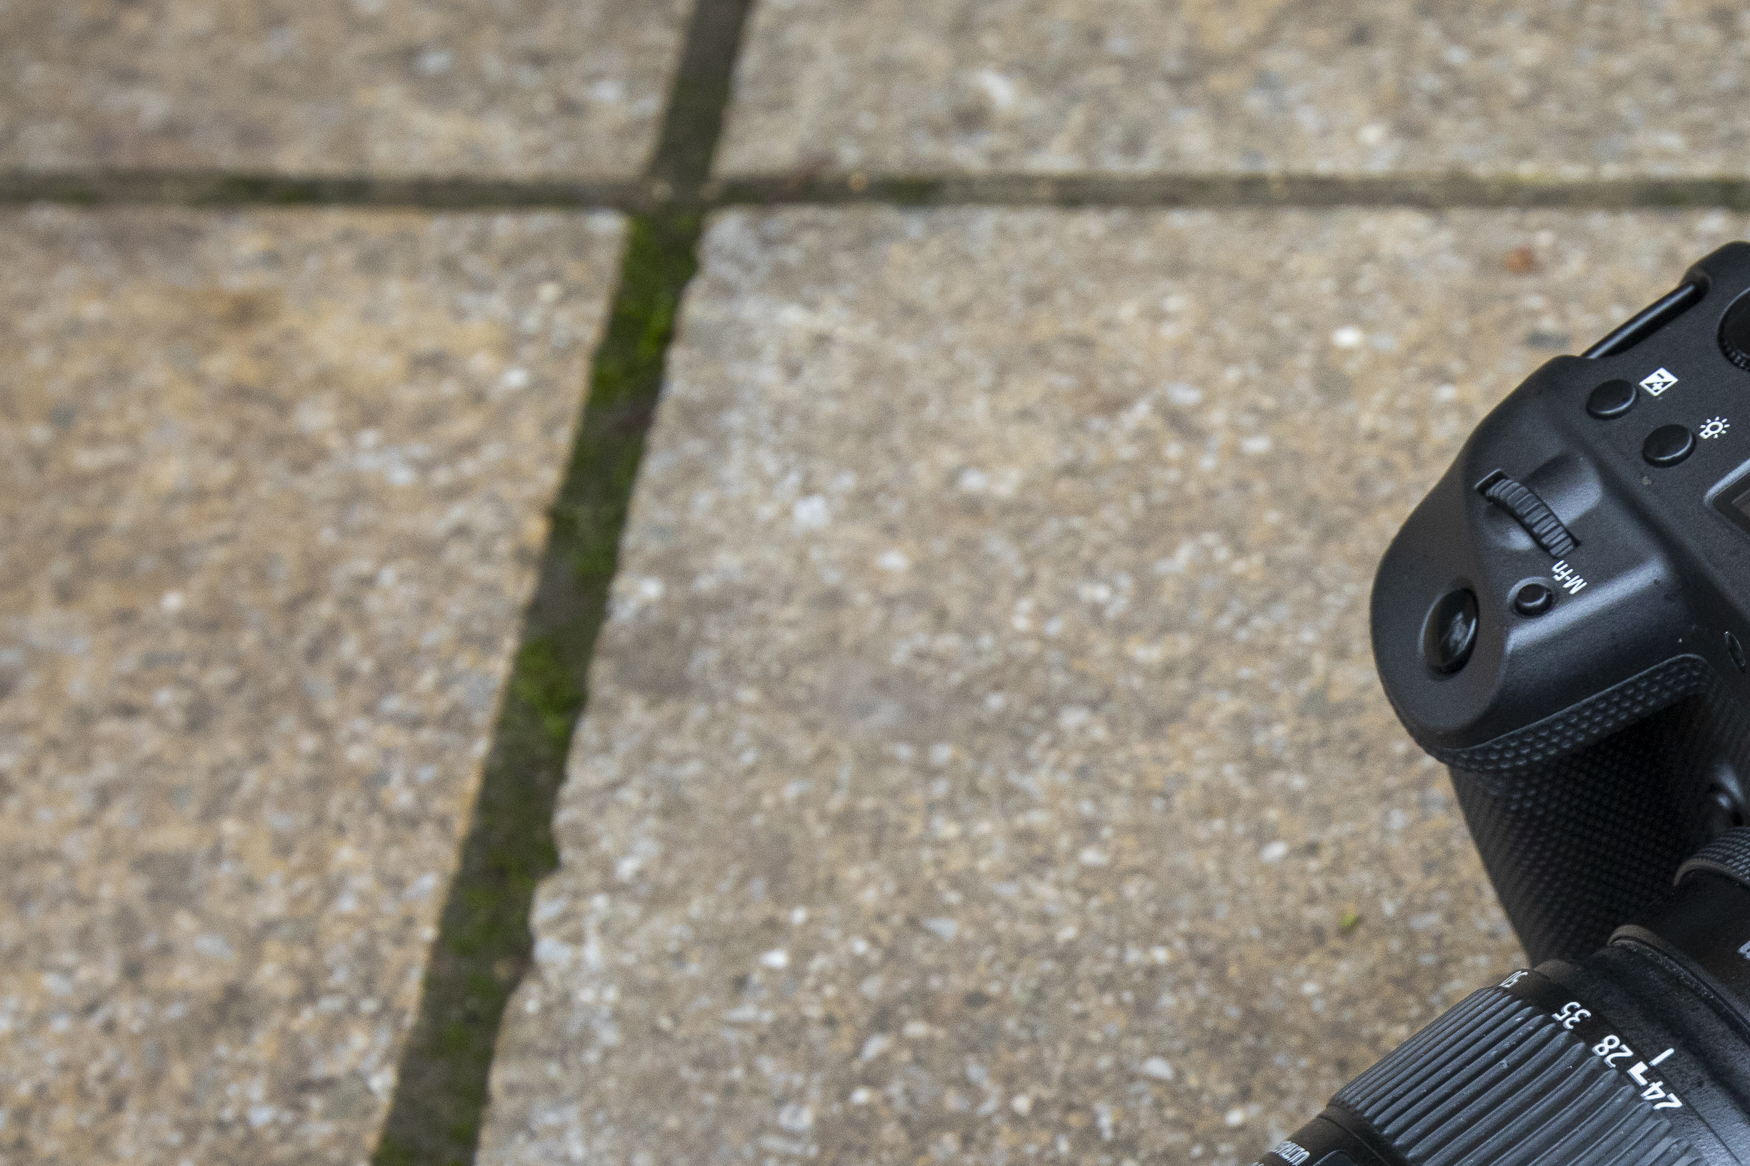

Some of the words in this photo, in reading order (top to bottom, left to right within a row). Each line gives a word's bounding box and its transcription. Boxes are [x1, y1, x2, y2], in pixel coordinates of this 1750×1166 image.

[1552, 560, 1587, 594] M-Fn
[1551, 1001, 1592, 1030] 35
[1591, 1034, 1634, 1069] 28
[1640, 1080, 1683, 1110] 24
